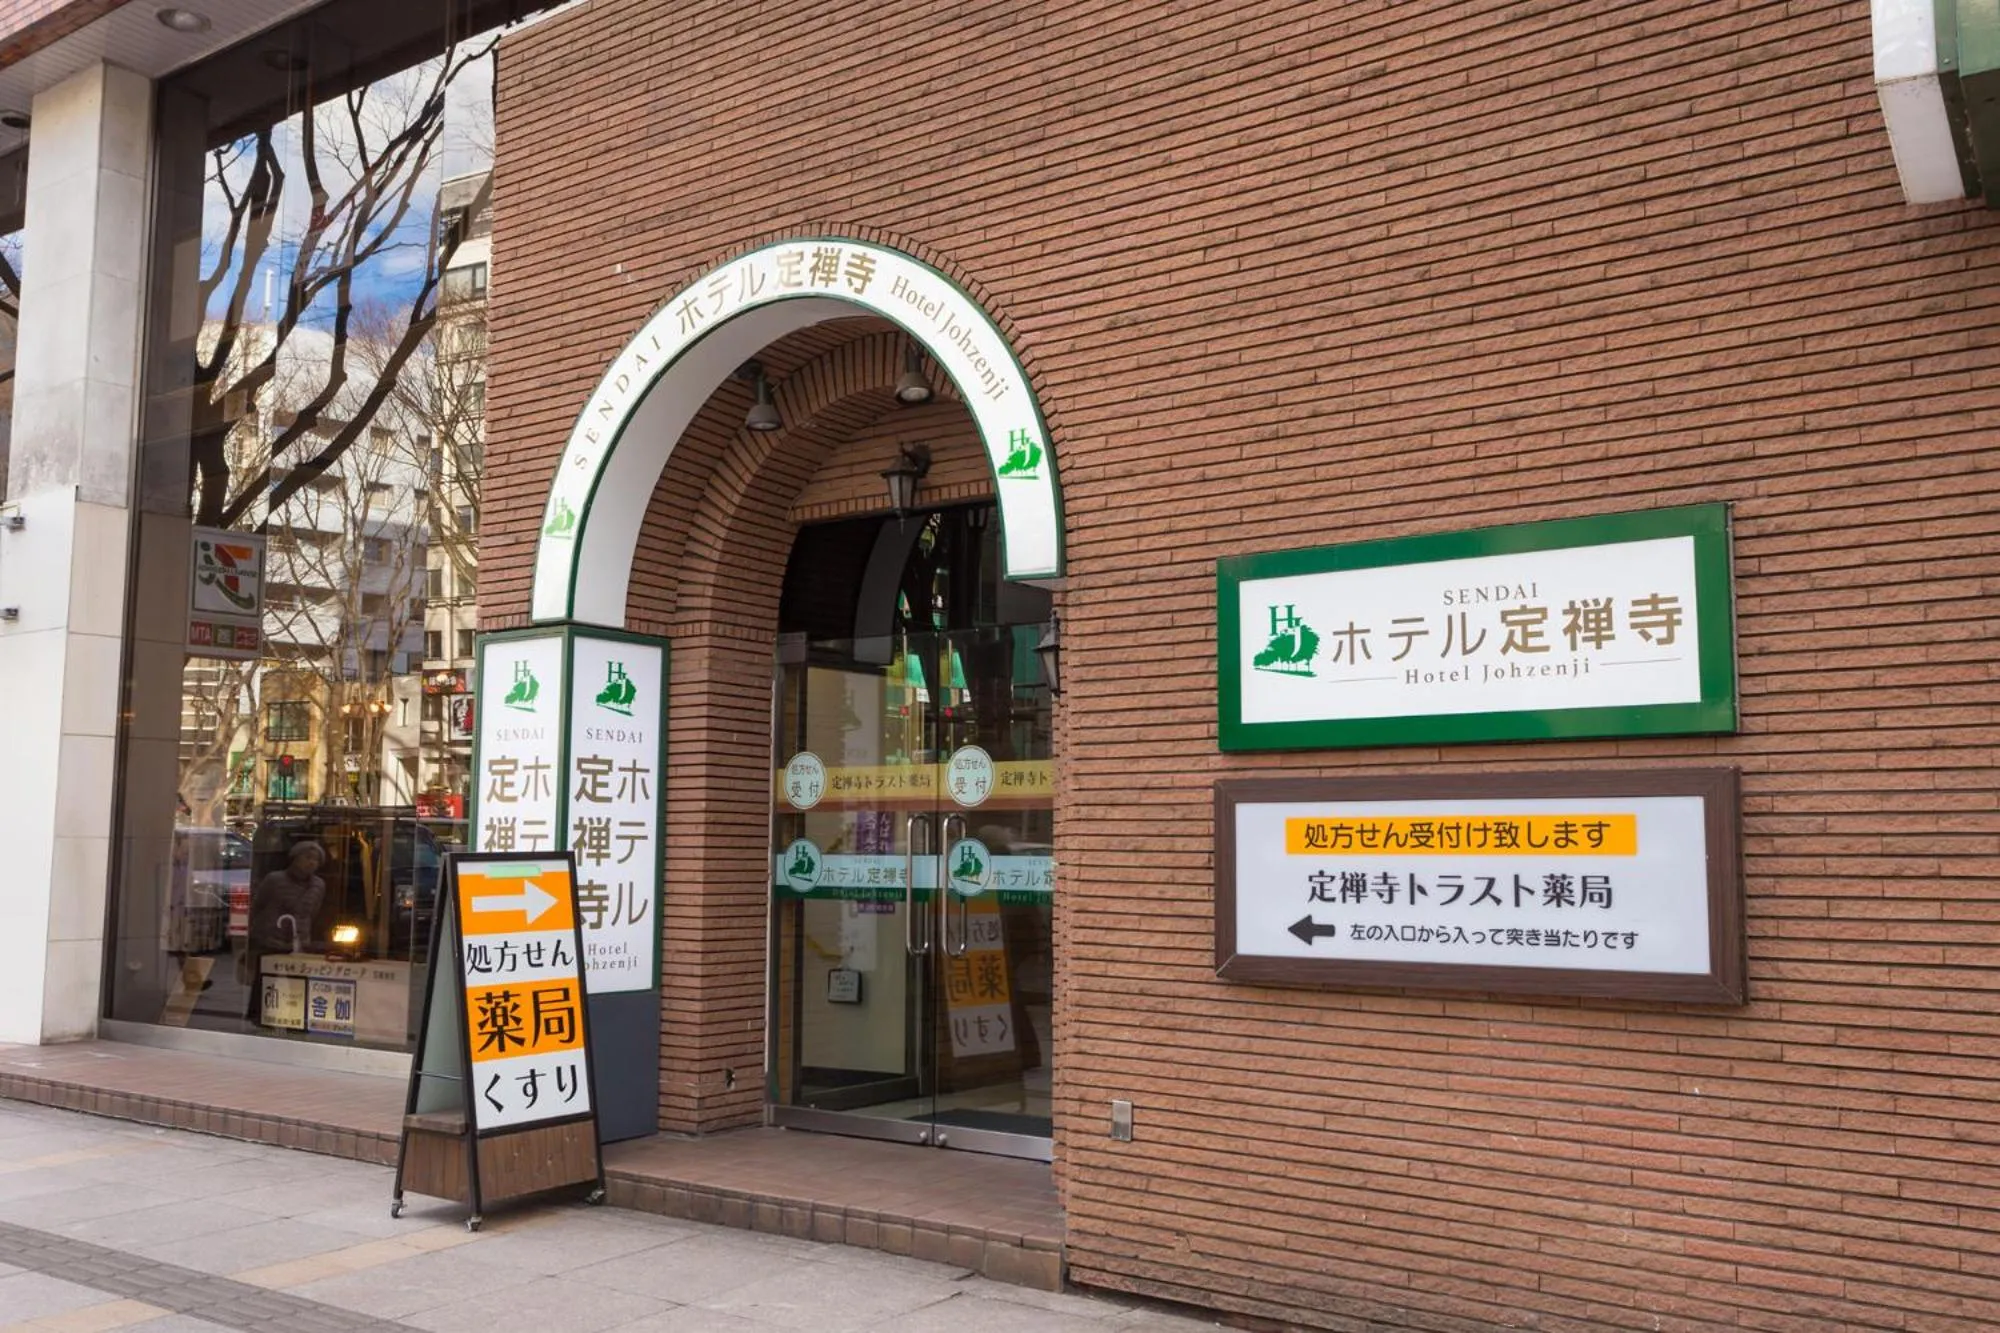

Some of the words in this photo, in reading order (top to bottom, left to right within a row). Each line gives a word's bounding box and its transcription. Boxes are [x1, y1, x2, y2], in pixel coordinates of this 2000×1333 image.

[889, 275, 945, 322] Hotel
[938, 312, 1010, 402] Johzenji
[574, 335, 662, 470] SENDAI
[1442, 582, 1538, 606] SENDAI
[1332, 592, 1683, 666] ホテル定禅寺
[1404, 665, 1470, 684] Hotel
[1483, 657, 1590, 684] Johzenji
[495, 727, 545, 742] SENDAI
[585, 727, 644, 745] SENDAI
[1303, 820, 1611, 850] 処方せん受付け致します
[1306, 870, 1613, 909] 定禅寺トラスト薬局
[587, 942, 628, 956] Hotel
[1349, 922, 1640, 950] 左の入口から入って突き当たりです
[466, 939, 574, 976] 処方せん
[584, 955, 638, 971] ohzenji
[474, 986, 577, 1053] 薬局
[483, 1064, 578, 1113] くすり
